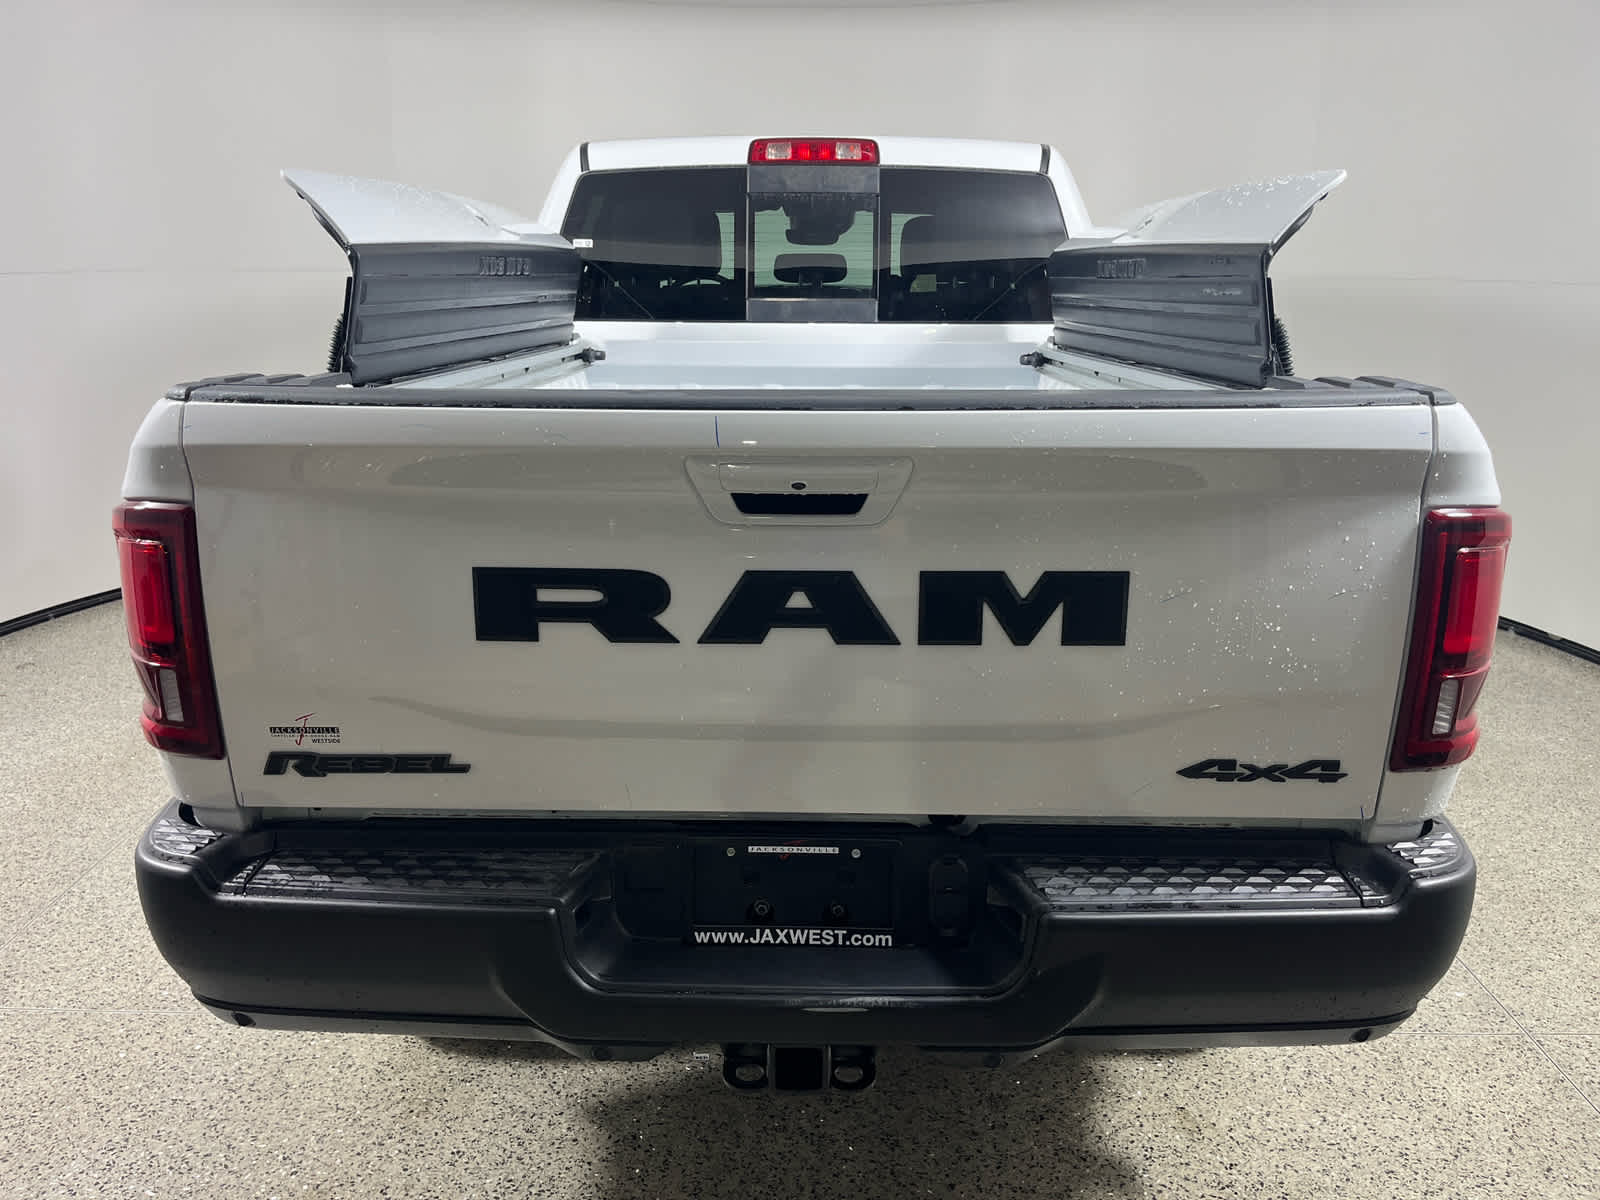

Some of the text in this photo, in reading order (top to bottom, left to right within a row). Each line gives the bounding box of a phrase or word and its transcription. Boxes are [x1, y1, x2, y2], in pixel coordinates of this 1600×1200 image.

[472, 567, 1130, 646] RAM
[269, 726, 340, 734] JACKSONVILLE
[1176, 758, 1349, 783] 4x4
[749, 846, 839, 854] JACKSONVILLE
[694, 928, 893, 947] www.JAXWEST.com
